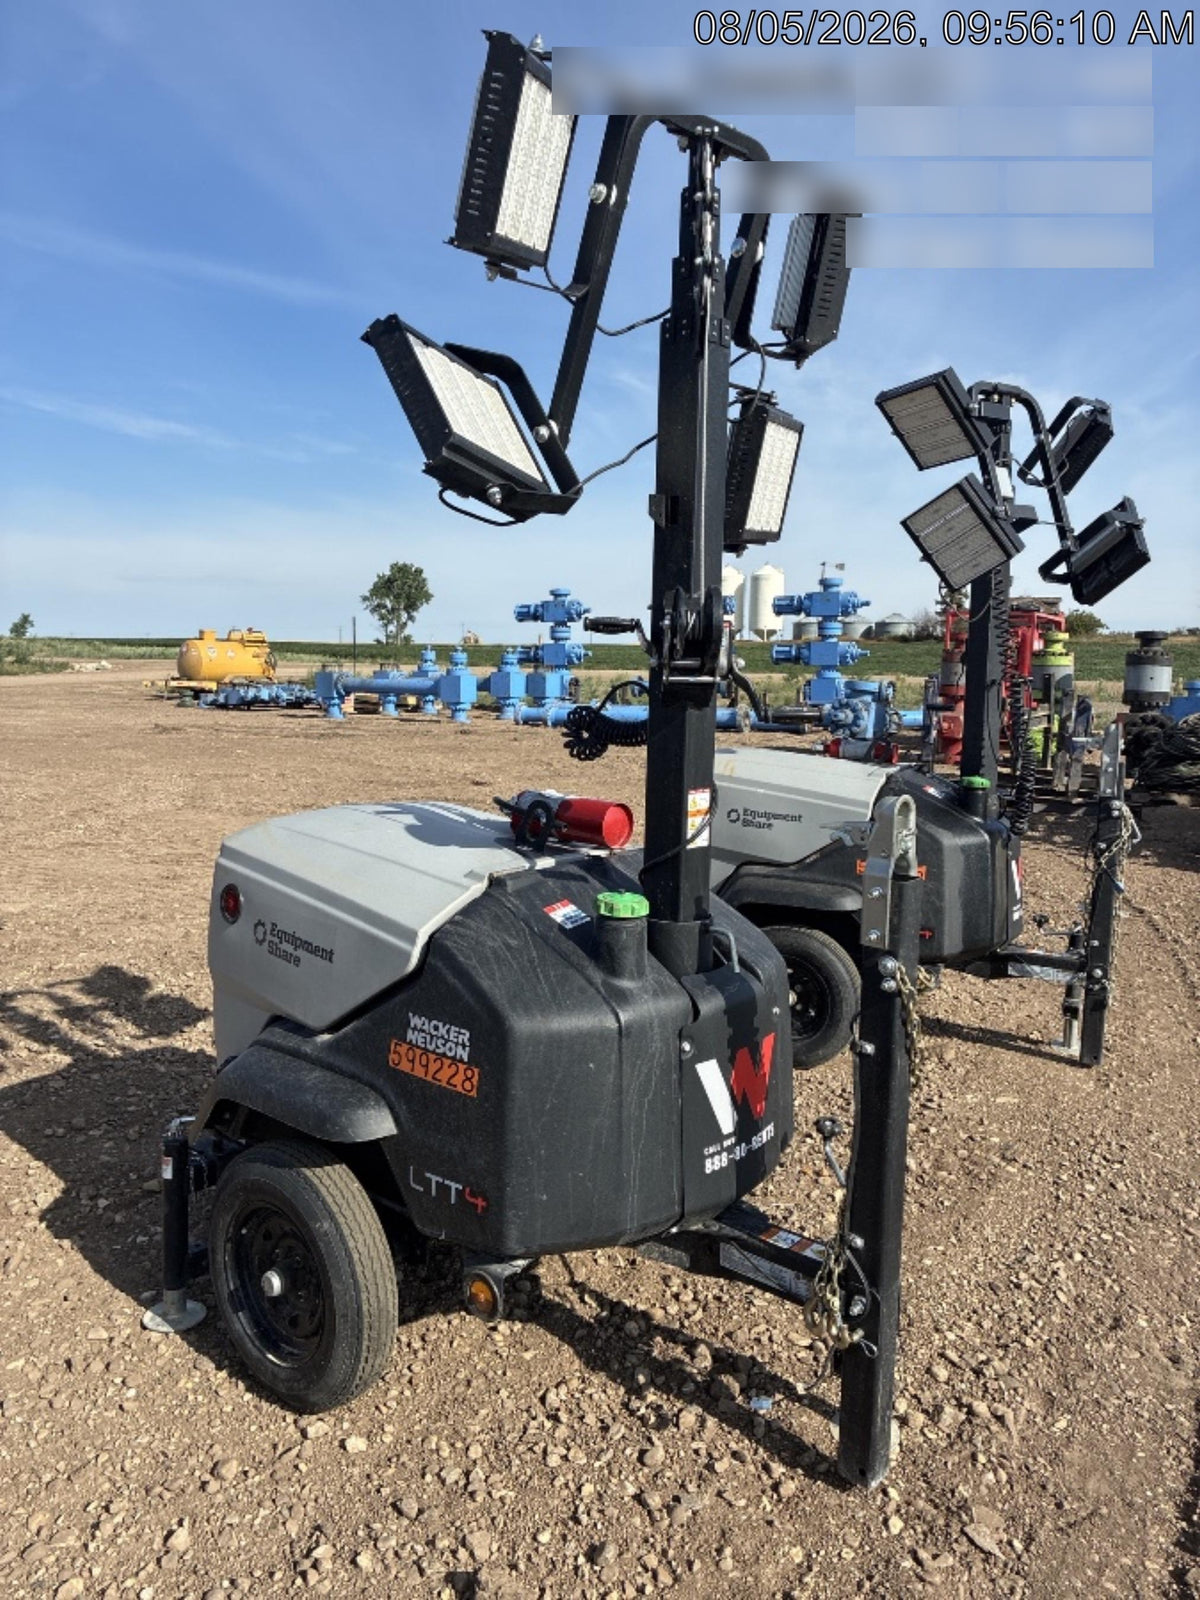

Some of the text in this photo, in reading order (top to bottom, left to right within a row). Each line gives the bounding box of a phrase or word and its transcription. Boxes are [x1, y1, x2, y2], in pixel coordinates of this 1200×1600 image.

[267, 940, 301, 968] Share
[270, 922, 334, 964] Equipment
[406, 1028, 470, 1062] NEUSON
[408, 1012, 470, 1046] WACKER
[391, 1042, 476, 1093] 599228
[410, 1166, 487, 1214] LTT4
